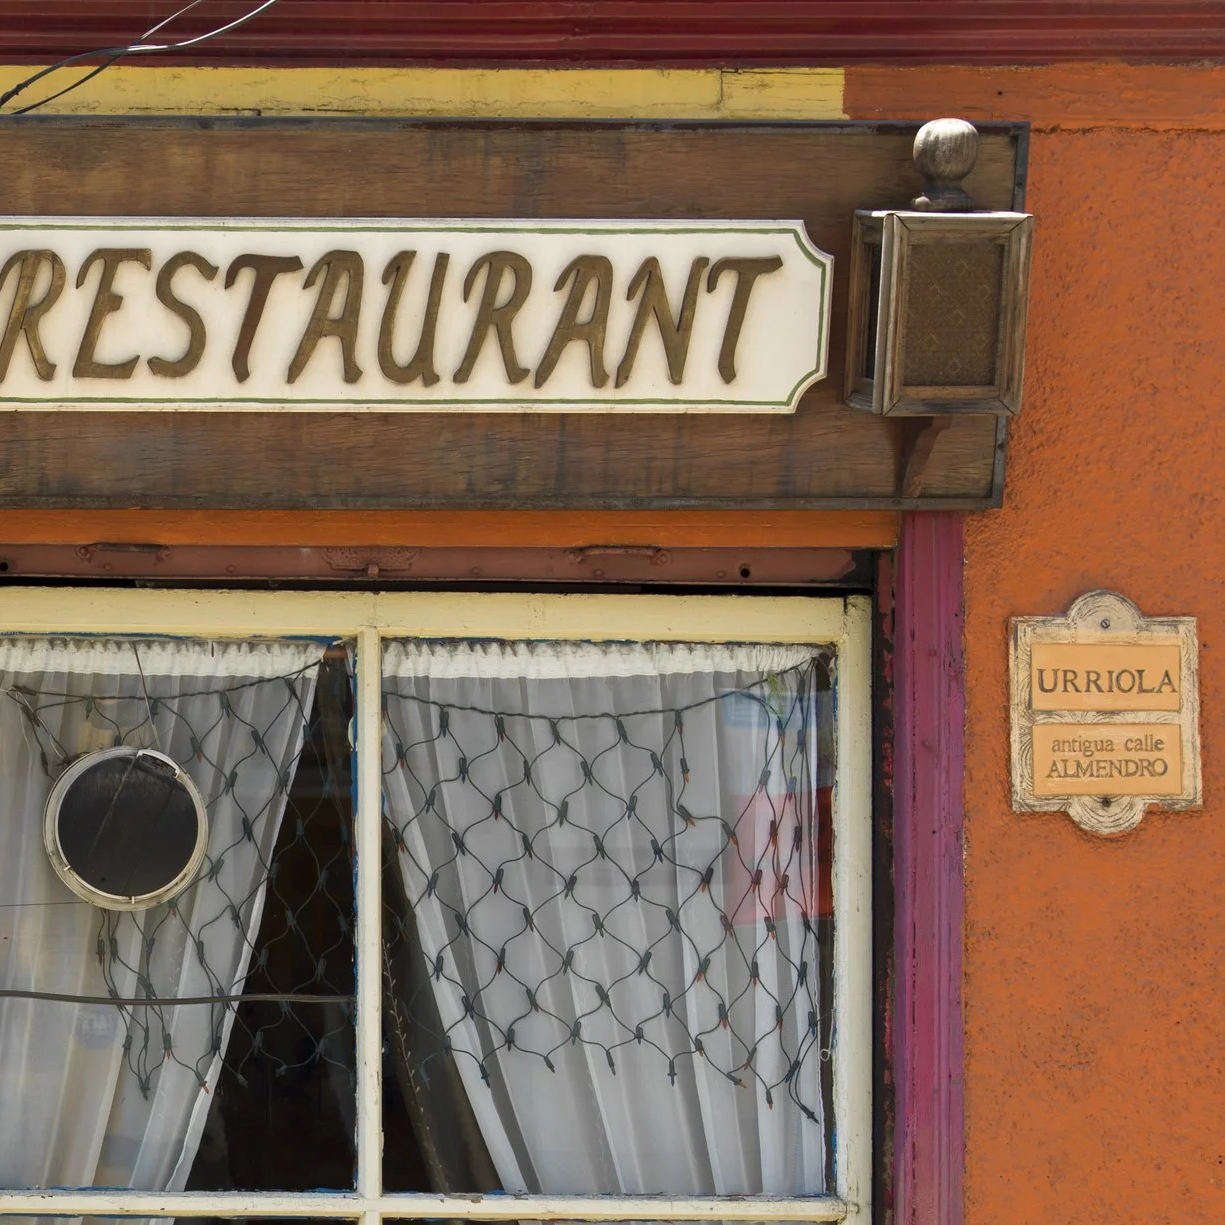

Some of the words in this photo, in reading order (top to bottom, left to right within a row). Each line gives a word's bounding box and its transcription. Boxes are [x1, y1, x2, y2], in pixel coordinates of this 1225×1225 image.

[1036, 668, 1178, 694] URRIOLA
[1051, 735, 1116, 757] antigua
[1124, 734, 1165, 752] calle
[1046, 758, 1169, 779] ALMENDRO
